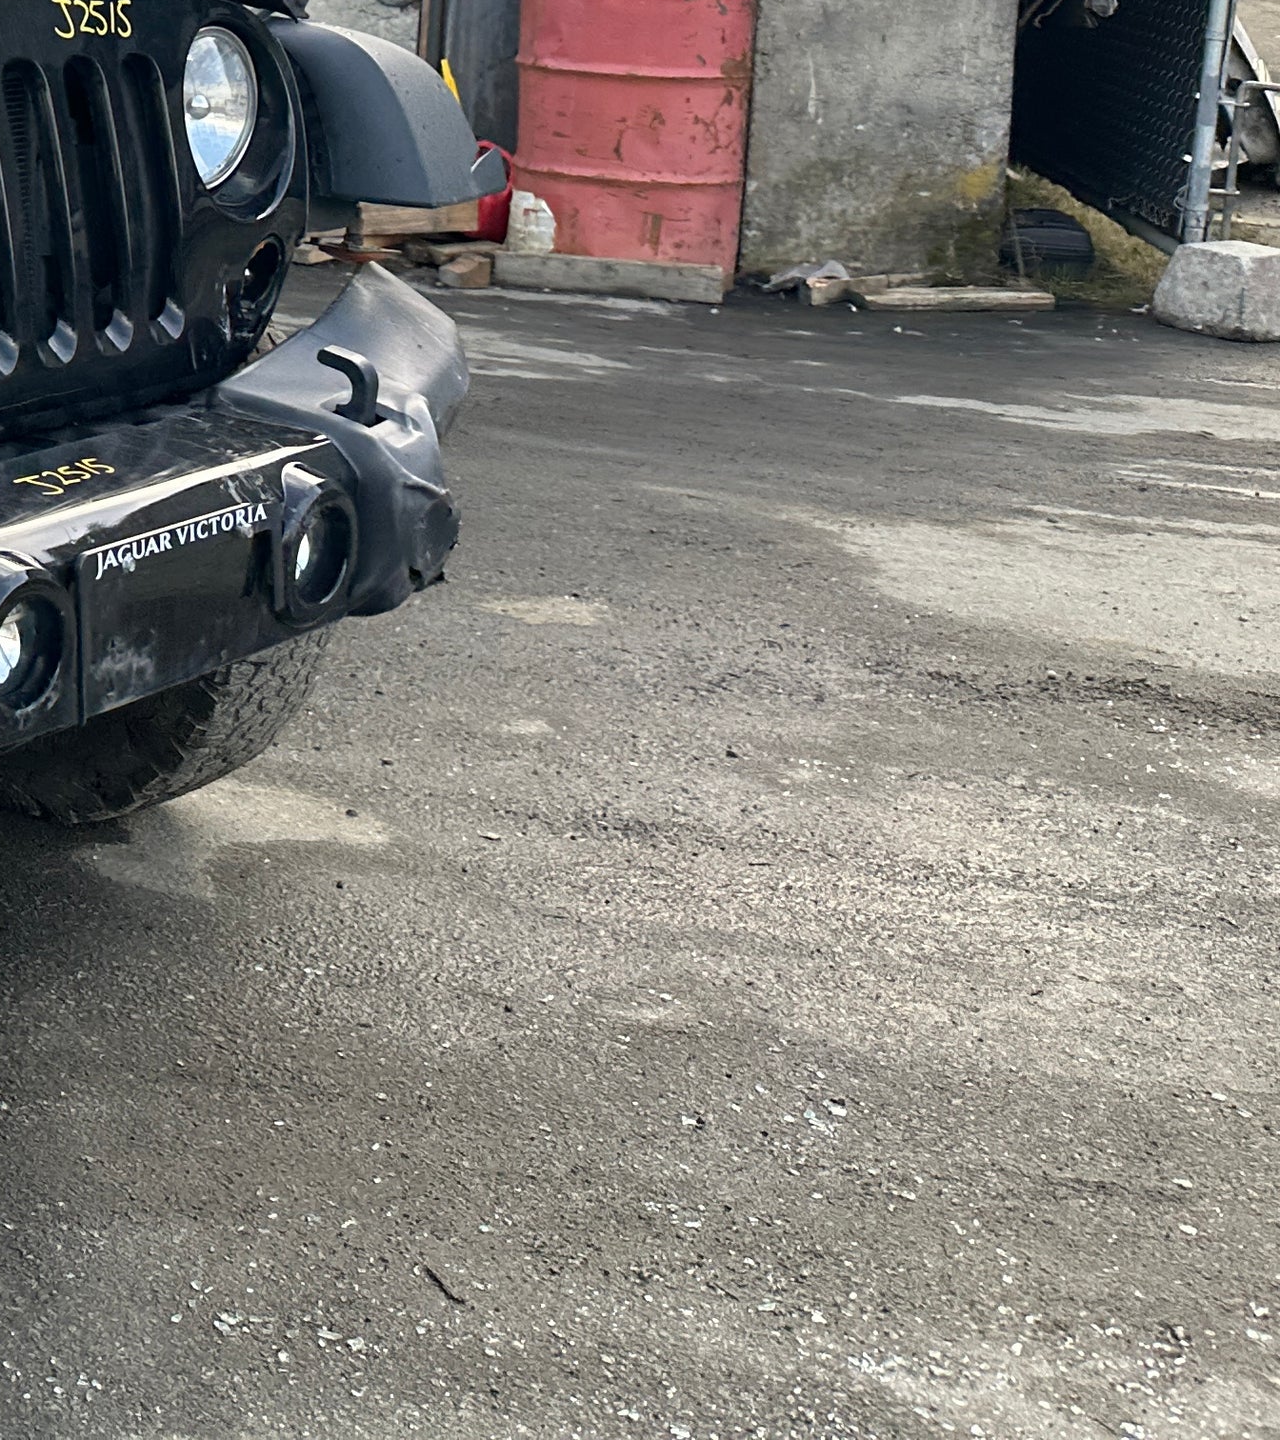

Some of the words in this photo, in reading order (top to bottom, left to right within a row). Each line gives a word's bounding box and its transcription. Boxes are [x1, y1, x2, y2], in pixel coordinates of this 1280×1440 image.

[12, 457, 117, 496] J2515
[94, 530, 174, 580] JAGUAR
[175, 503, 268, 547] VICTORIA
